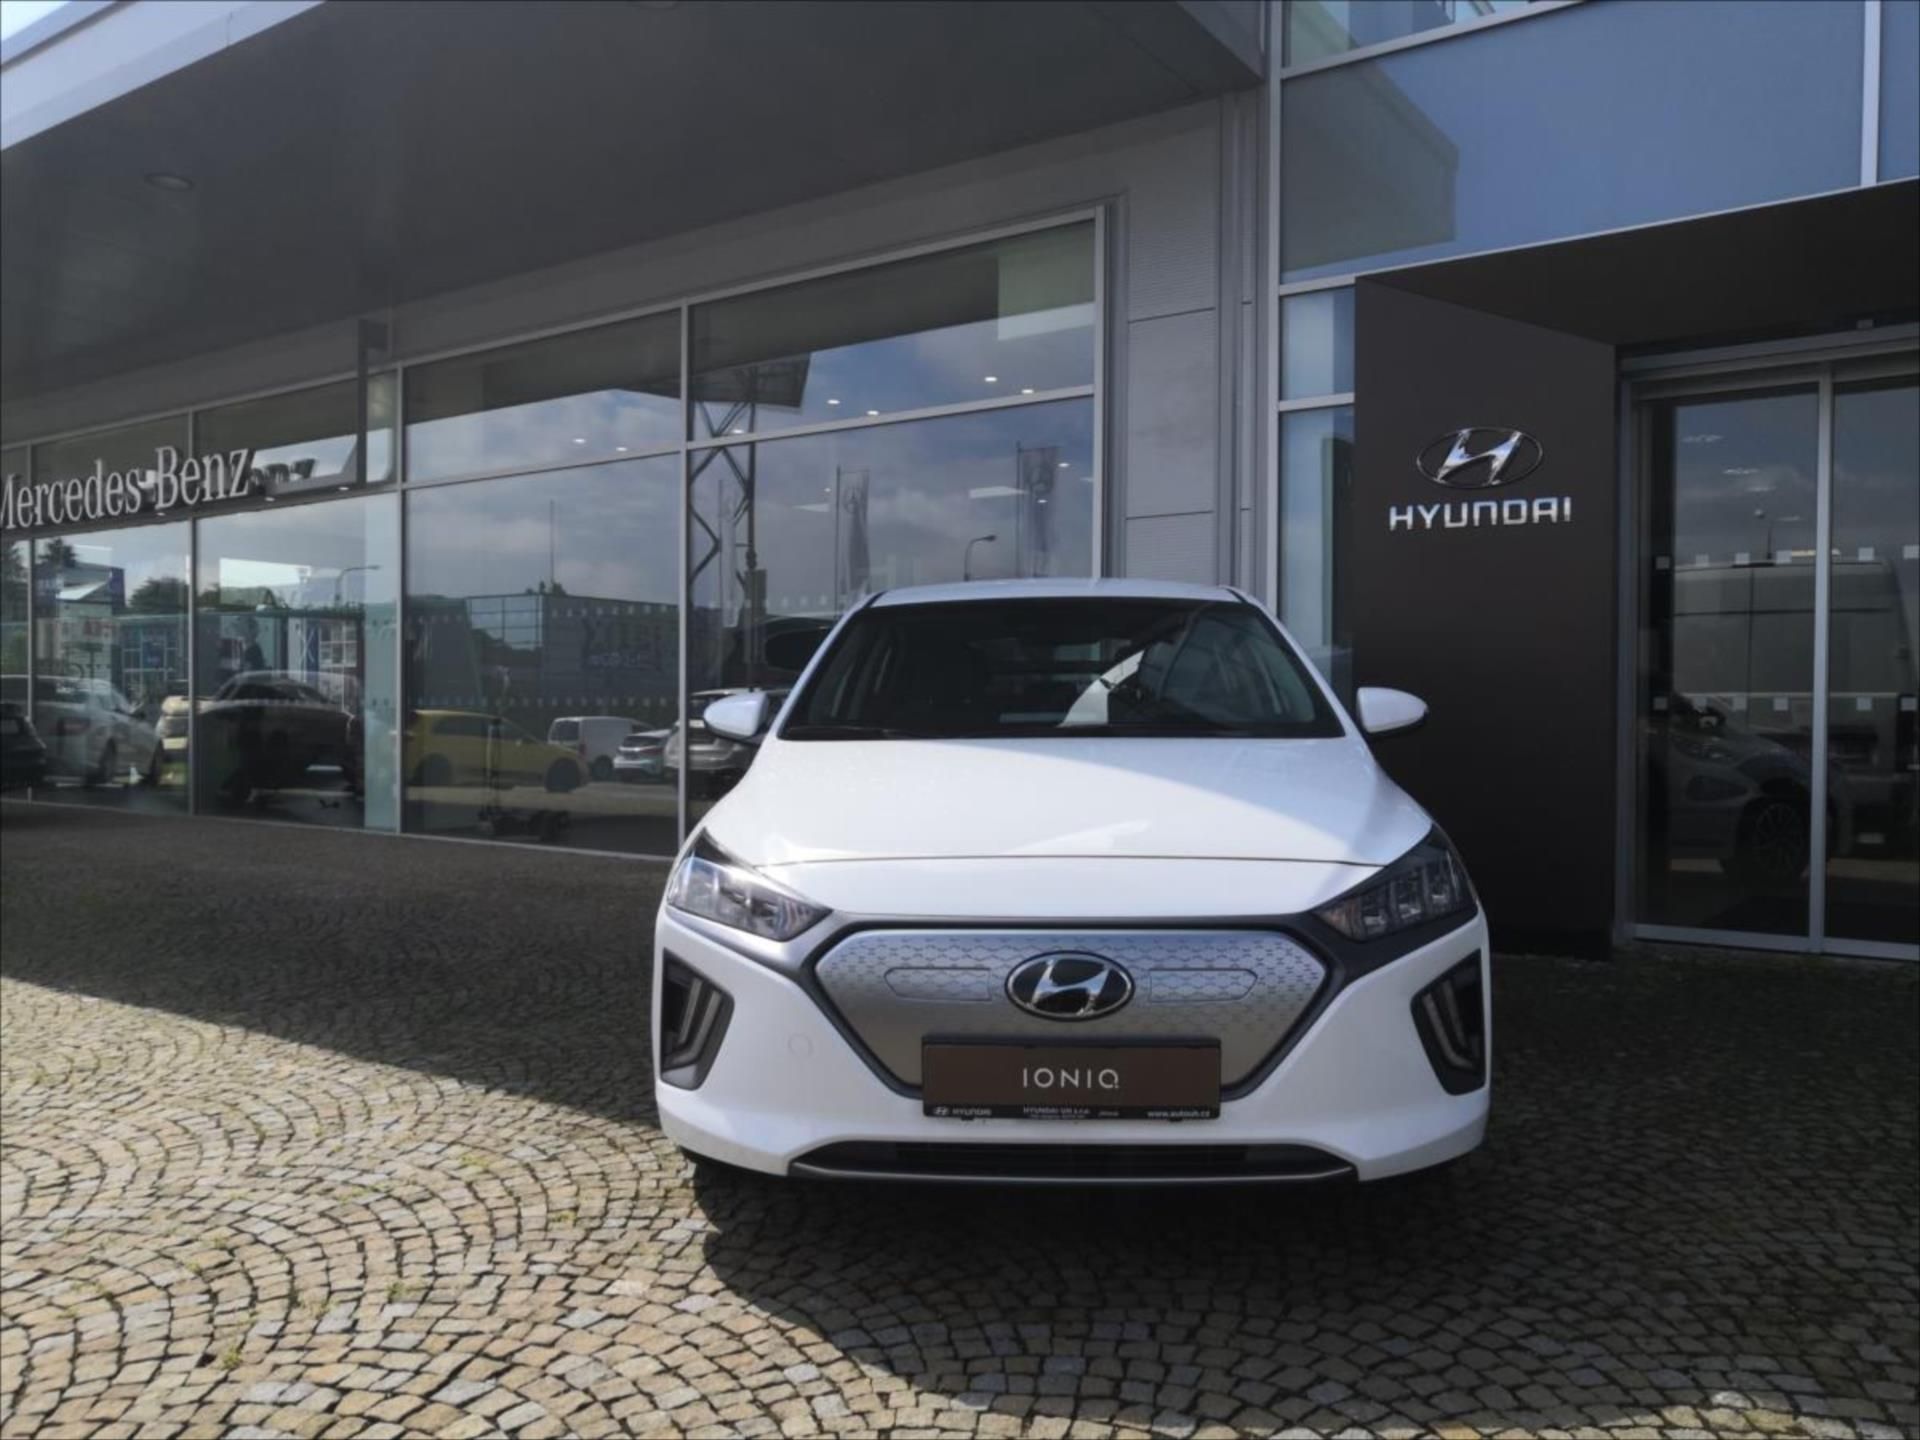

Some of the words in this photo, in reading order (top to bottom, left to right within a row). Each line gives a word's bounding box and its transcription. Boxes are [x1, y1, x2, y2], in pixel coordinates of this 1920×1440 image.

[1389, 496, 1572, 532] HYUNDAI
[1021, 1067, 1120, 1090] IONIQ
[952, 1107, 992, 1117] HYUNDAI
